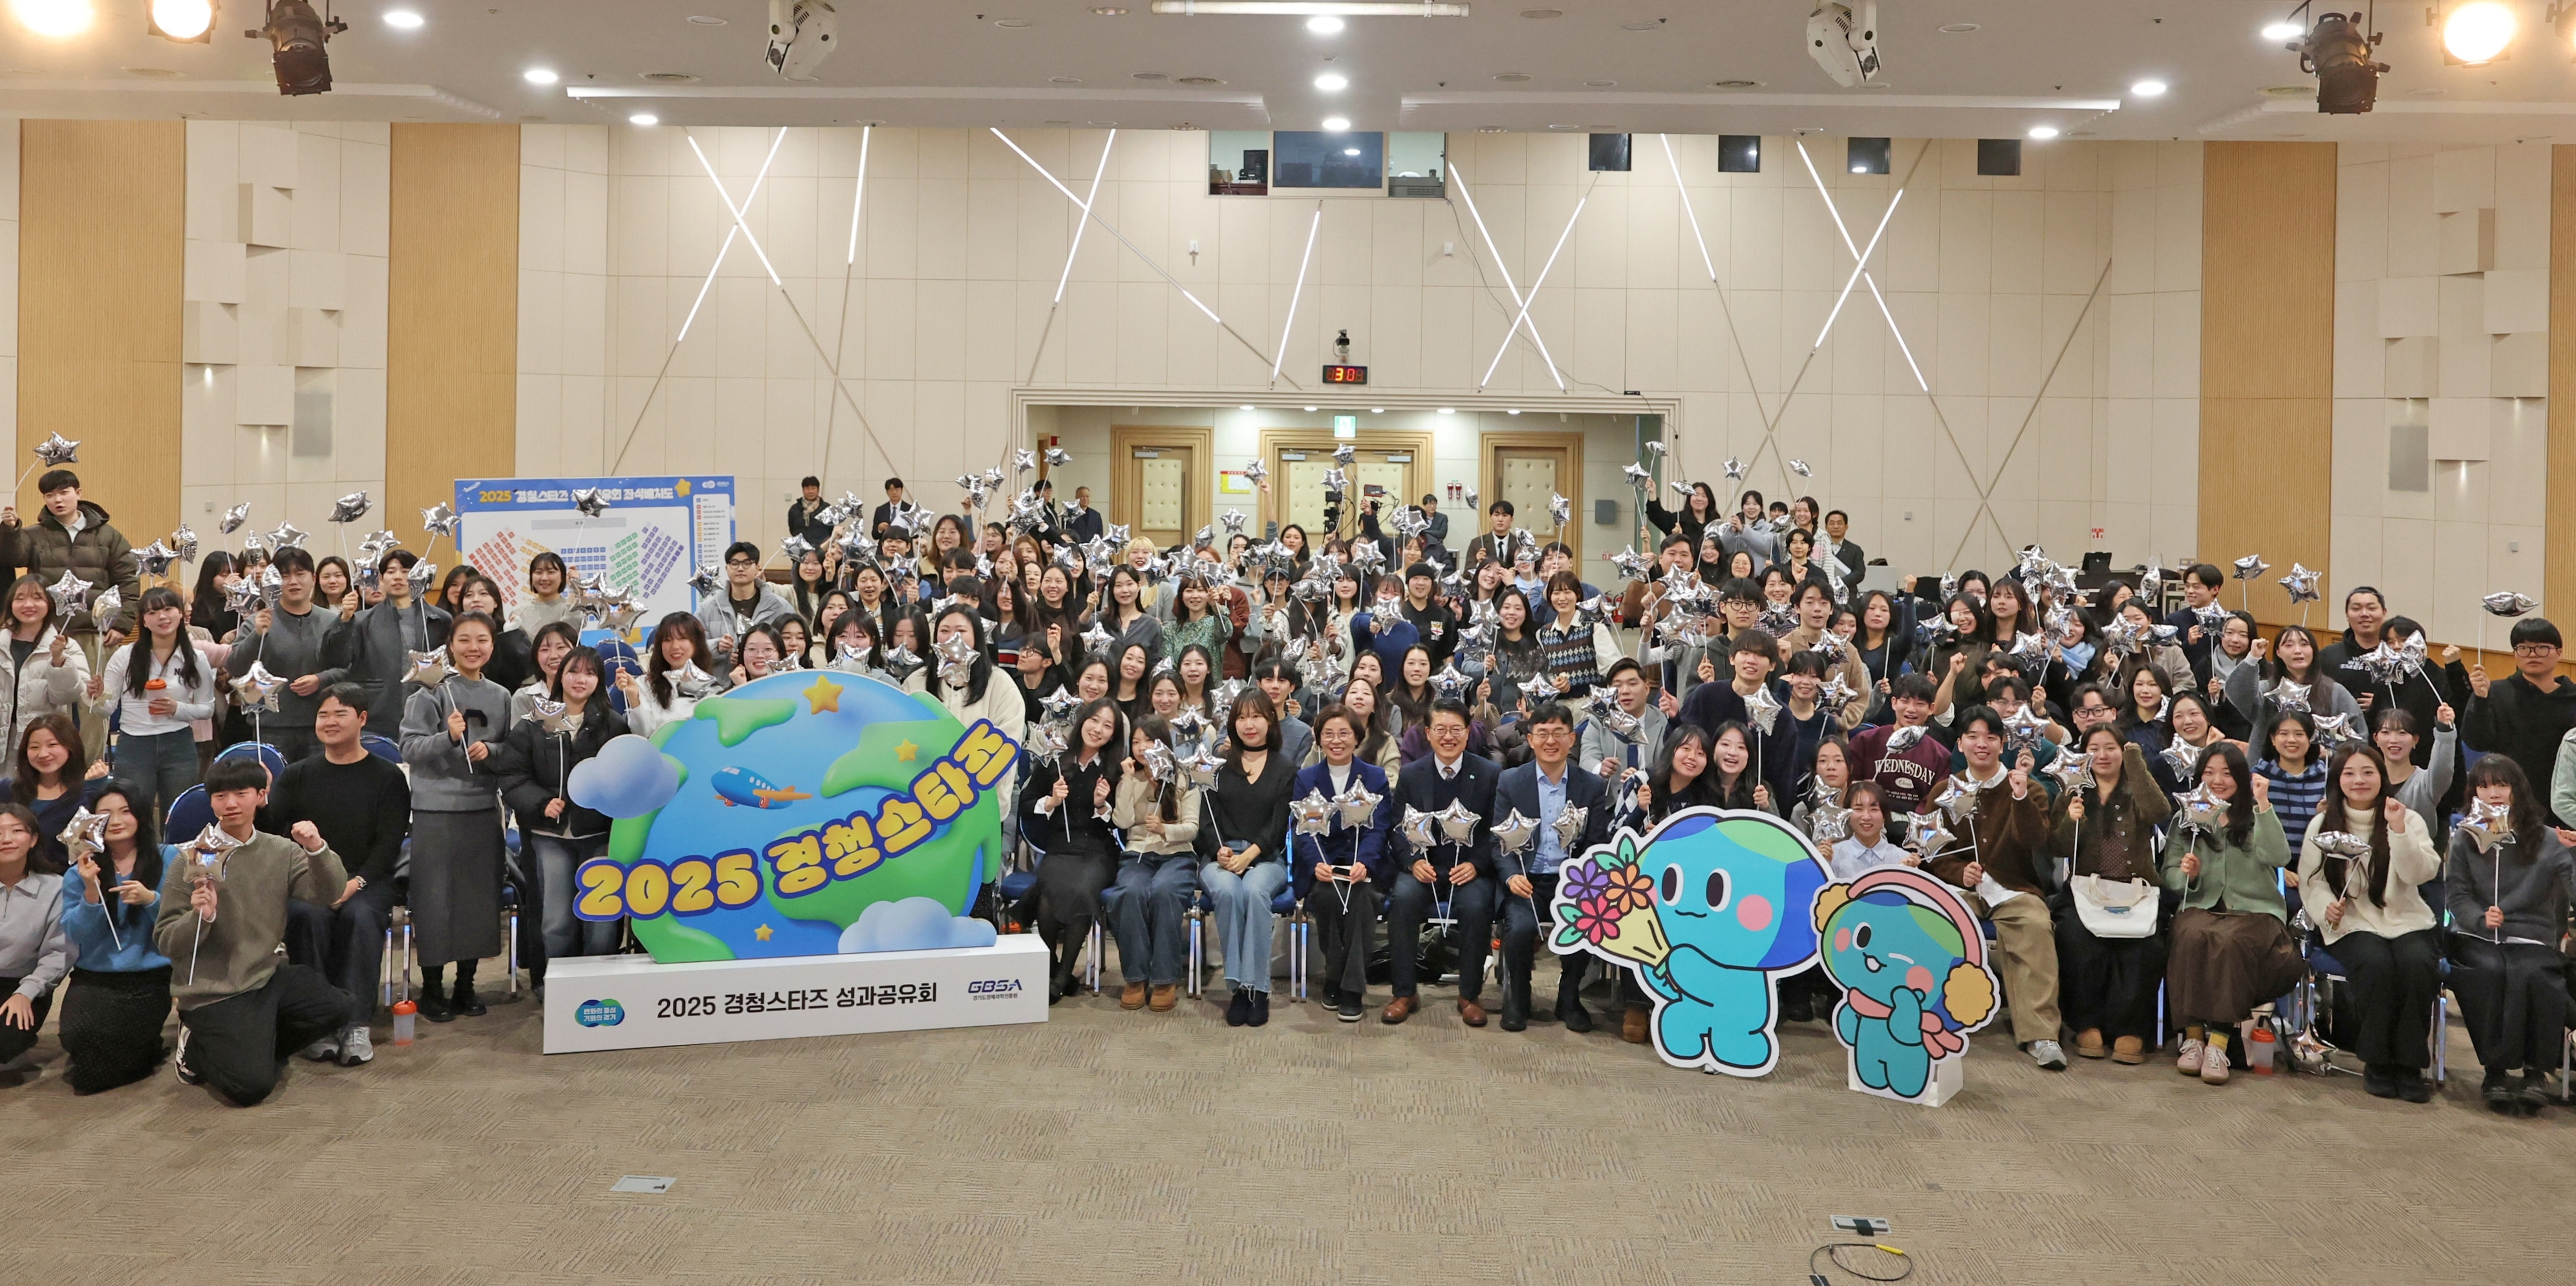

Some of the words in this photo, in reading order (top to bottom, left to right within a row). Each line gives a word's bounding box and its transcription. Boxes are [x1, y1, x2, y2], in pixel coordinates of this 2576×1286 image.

[478, 490, 512, 503] 2025
[515, 489, 569, 503] 경청스타즈
[623, 488, 674, 500] 좌석배치도
[1874, 758, 1935, 786] WEDNESDAY
[579, 852, 760, 917] 2025
[766, 722, 1018, 895] 경청스타즈
[968, 978, 1022, 993] GBSA
[657, 996, 716, 1018] 2025
[724, 989, 829, 1014] 경청스타즈
[836, 982, 937, 1008] 성과공유회
